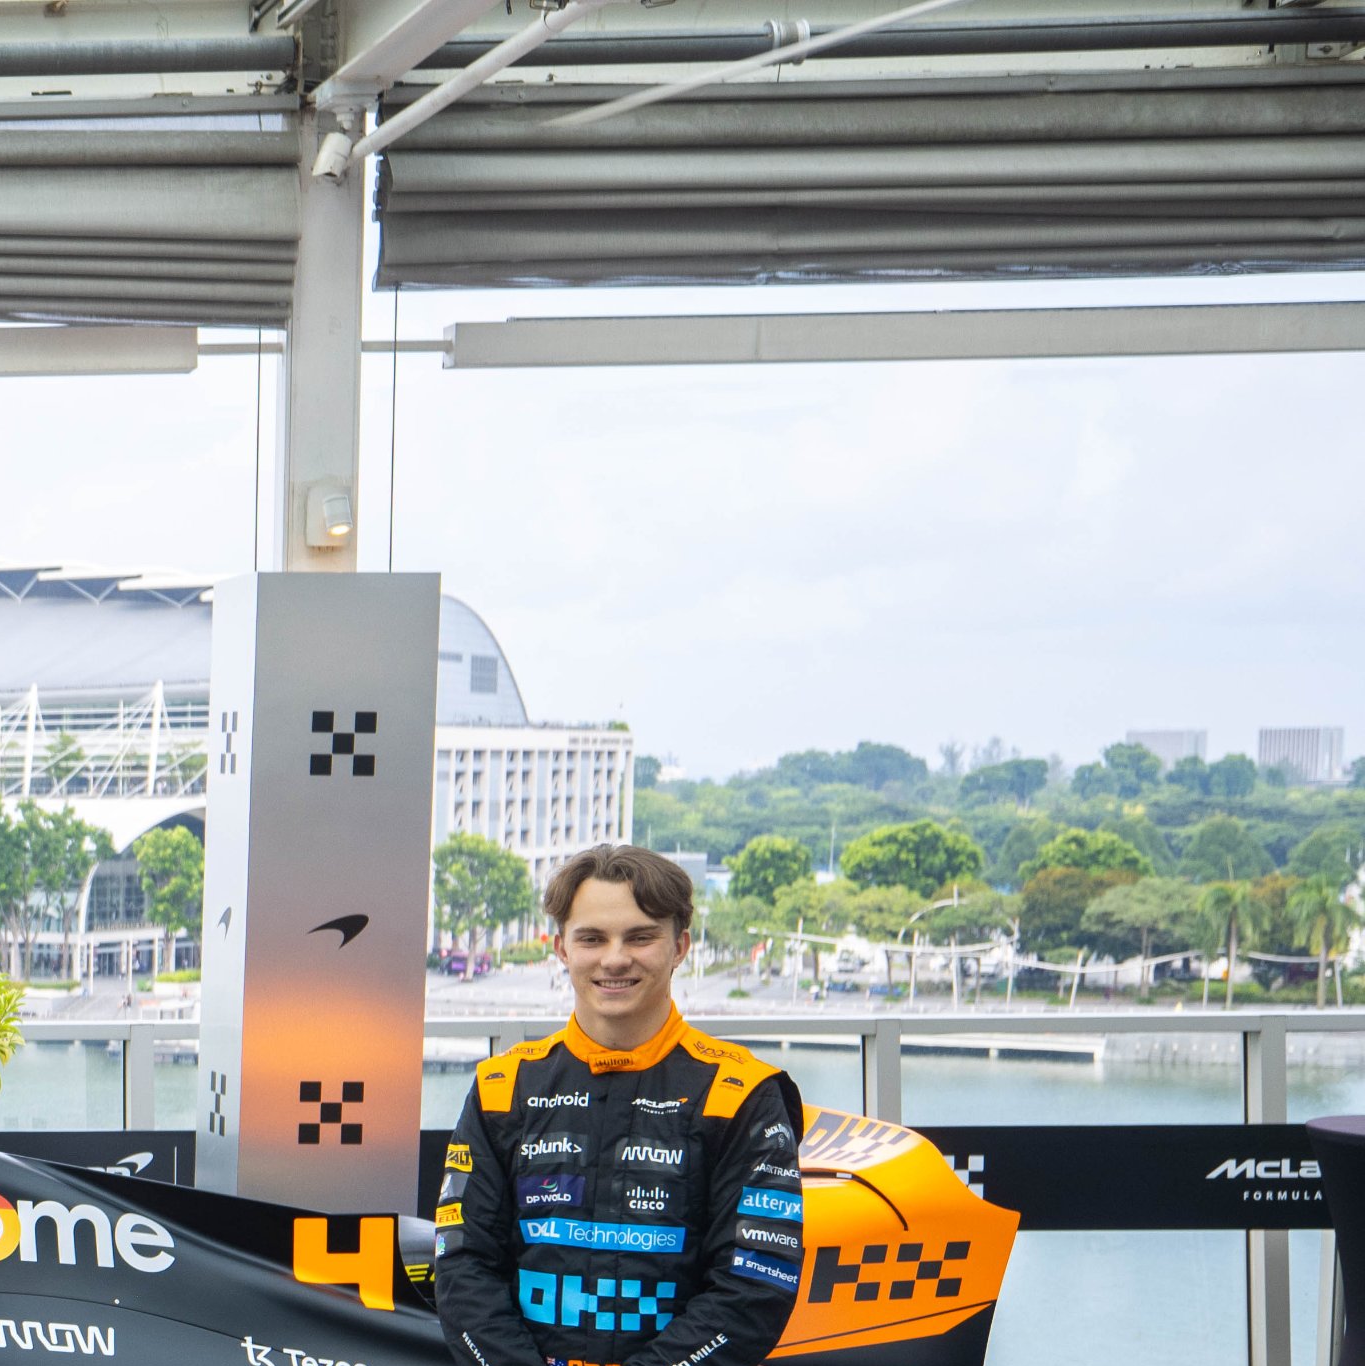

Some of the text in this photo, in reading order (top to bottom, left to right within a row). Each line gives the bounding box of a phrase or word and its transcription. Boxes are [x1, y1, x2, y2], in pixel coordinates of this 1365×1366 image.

[527, 1092, 590, 1109] android
[800, 1111, 911, 1164] OKX
[621, 1147, 683, 1165] ARROW
[1205, 1158, 1322, 1180] McLa
[526, 1195, 540, 1204] DP
[743, 1192, 802, 1216] alteryx
[1243, 1190, 1323, 1201] FORMULA
[565, 1222, 676, 1250] Technologies
[742, 1228, 798, 1248] vmware
[293, 1216, 396, 1311] 4
[746, 1260, 799, 1285] smartsheet
[807, 1241, 971, 1304] KX
[519, 1268, 677, 1332] OKX
[690, 1333, 728, 1364] MILLE
